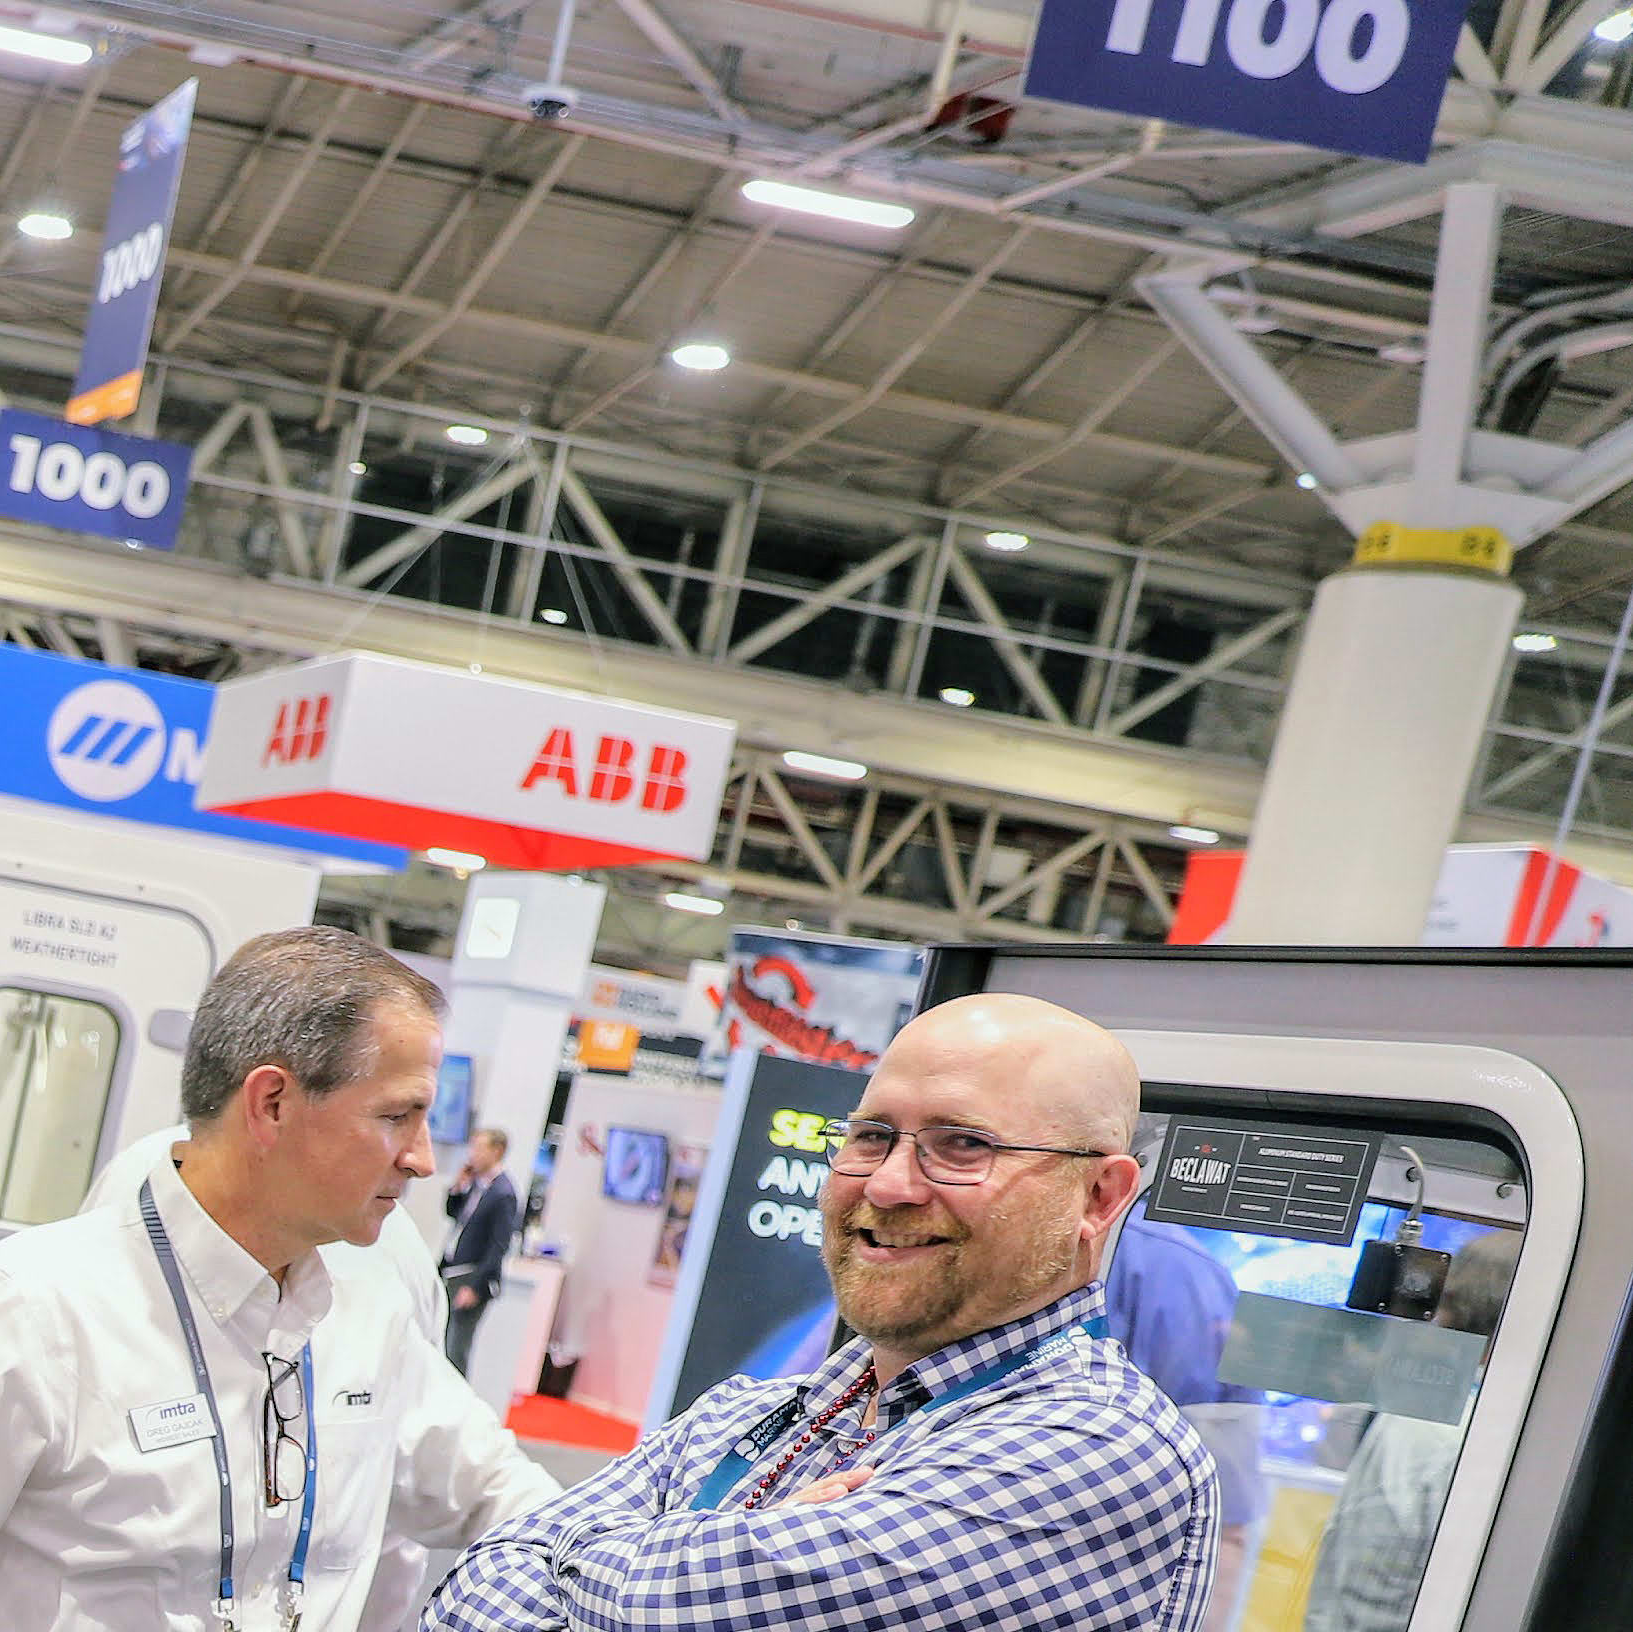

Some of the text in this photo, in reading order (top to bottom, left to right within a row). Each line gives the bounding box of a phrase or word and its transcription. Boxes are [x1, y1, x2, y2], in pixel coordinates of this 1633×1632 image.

[10, 434, 170, 519] 1000
[519, 727, 689, 814] ABB
[1170, 1156, 1231, 1185] BECLAWAT
[1025, 1336, 1067, 1362] MARINE
[159, 1402, 196, 1421] imtra
